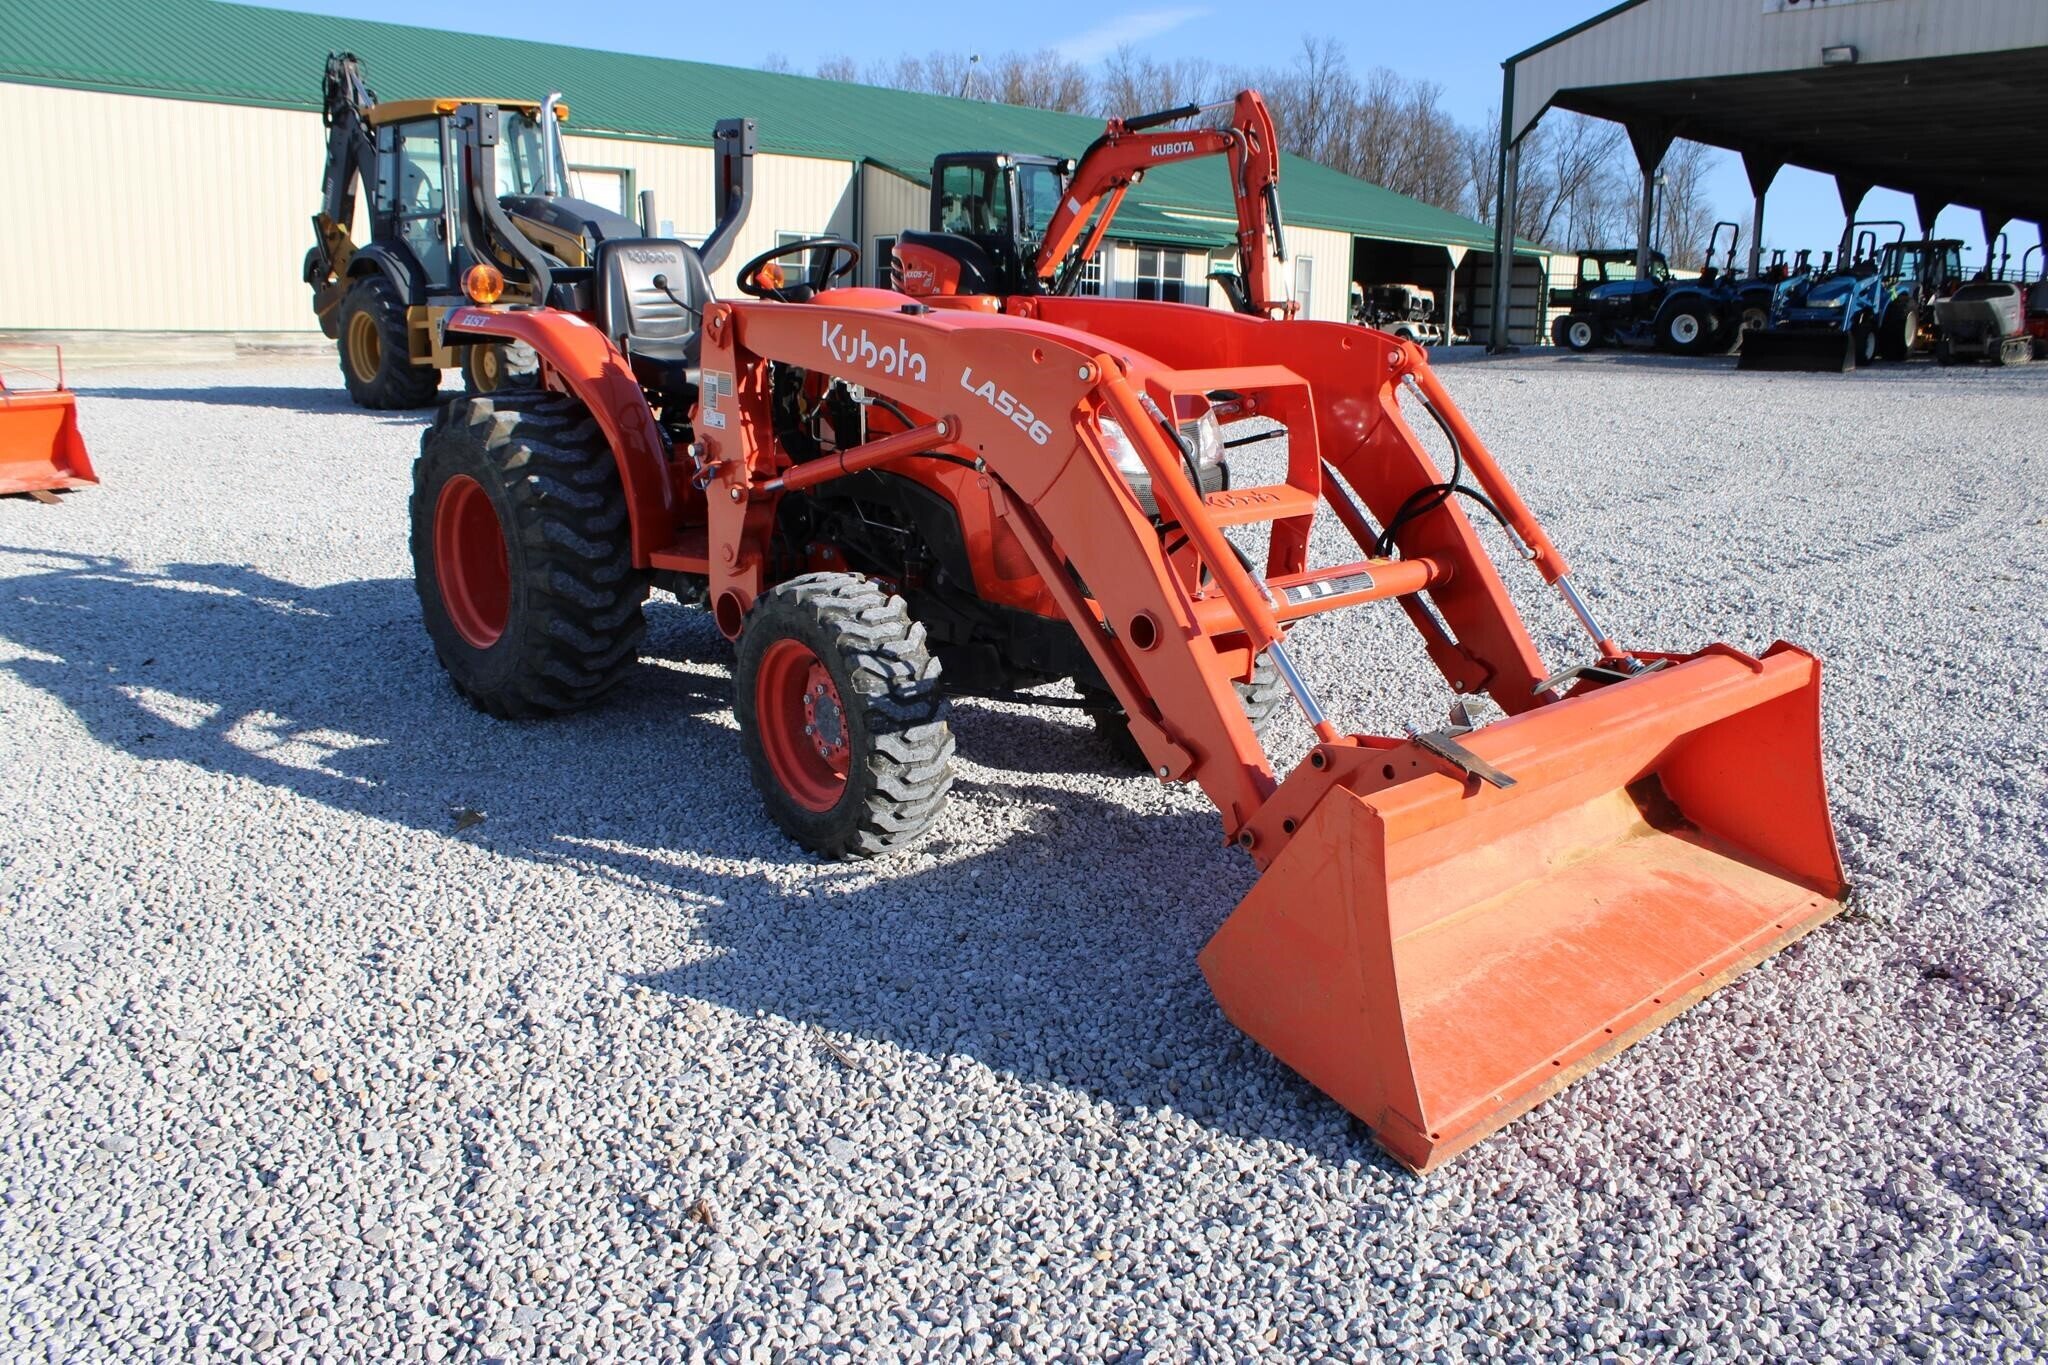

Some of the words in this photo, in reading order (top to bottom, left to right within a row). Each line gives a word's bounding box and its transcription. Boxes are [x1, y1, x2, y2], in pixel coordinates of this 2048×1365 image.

[1151, 141, 1195, 157] KUBOTA
[463, 314, 490, 328] HST
[821, 319, 927, 383] Kubota
[960, 366, 1053, 445] LA526
